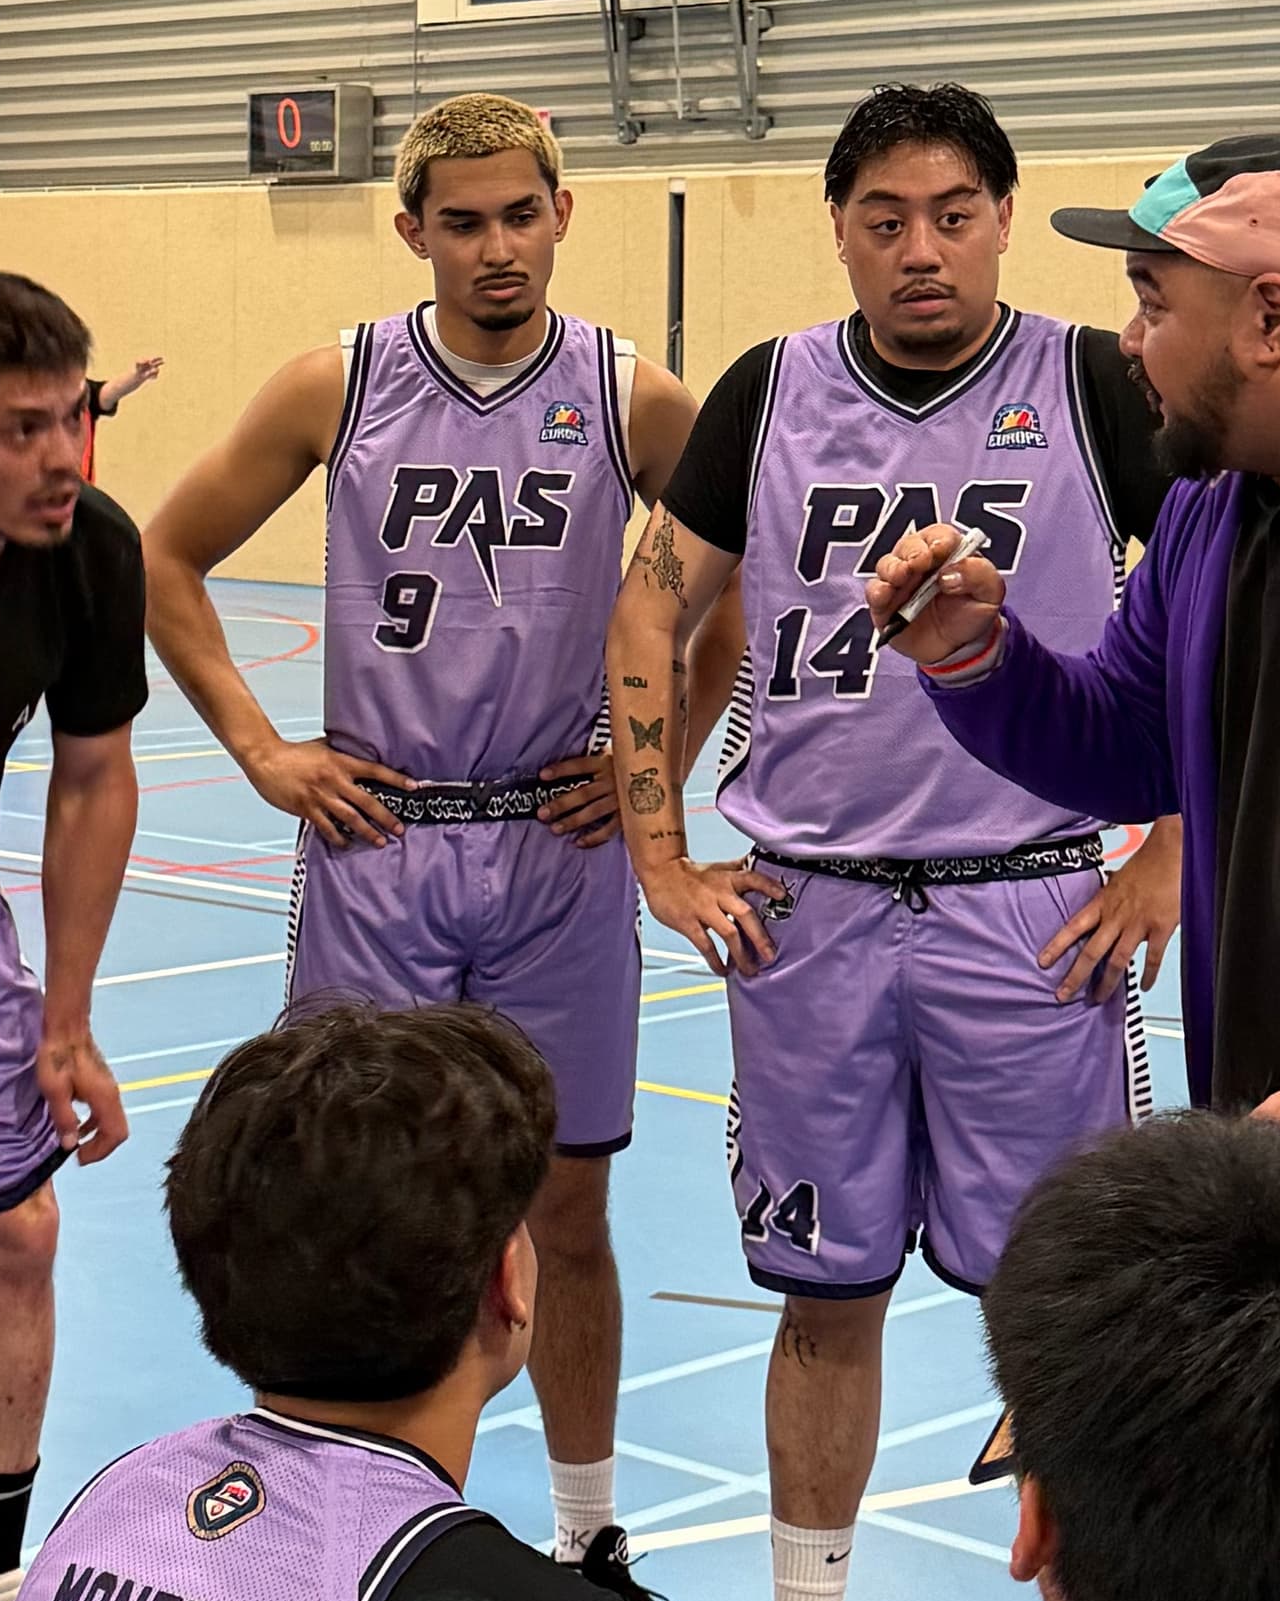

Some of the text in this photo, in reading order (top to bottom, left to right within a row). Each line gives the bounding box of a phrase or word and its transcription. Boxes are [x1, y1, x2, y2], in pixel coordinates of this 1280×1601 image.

[987, 431, 1047, 447] EUROPE
[379, 465, 576, 607] PAS
[795, 479, 1033, 586] PAS
[372, 571, 439, 654] 9
[766, 606, 879, 702] 14
[740, 1175, 821, 1257] 14
